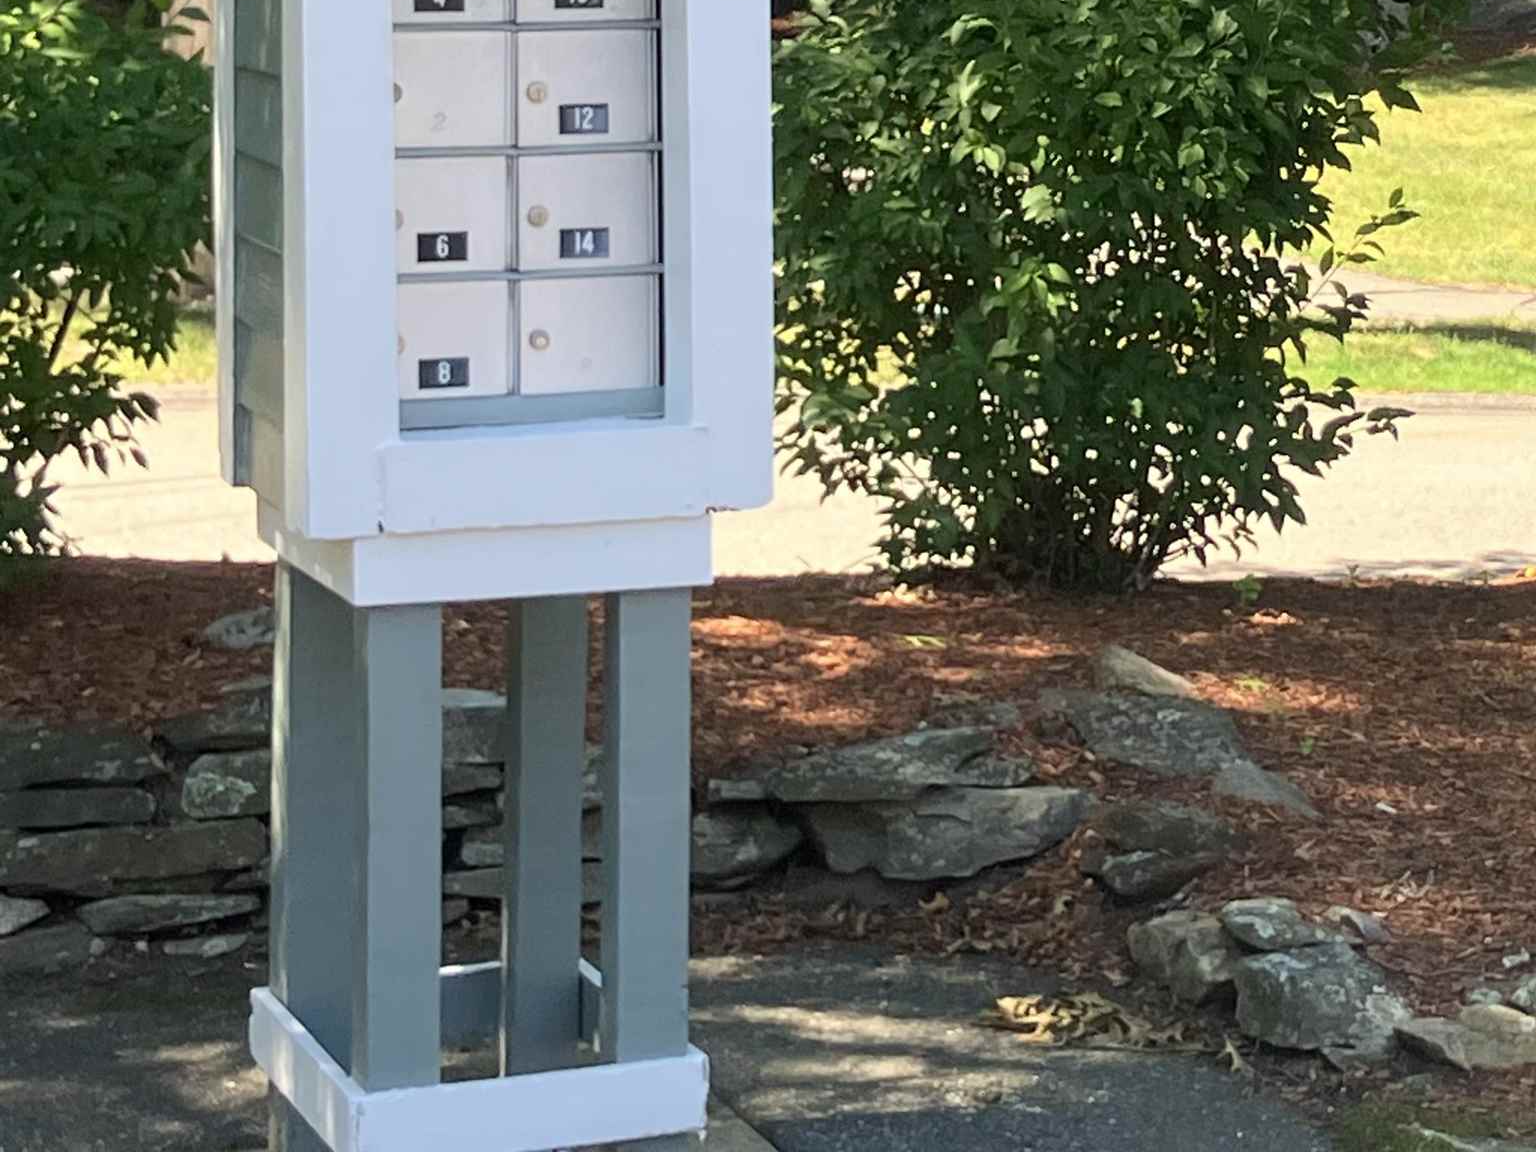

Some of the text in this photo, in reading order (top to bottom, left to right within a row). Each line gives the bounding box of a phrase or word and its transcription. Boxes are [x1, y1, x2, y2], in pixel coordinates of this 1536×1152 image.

[573, 106, 595, 131] 12
[436, 234, 449, 258] 6
[574, 230, 595, 256] 14
[437, 360, 451, 385] 8
